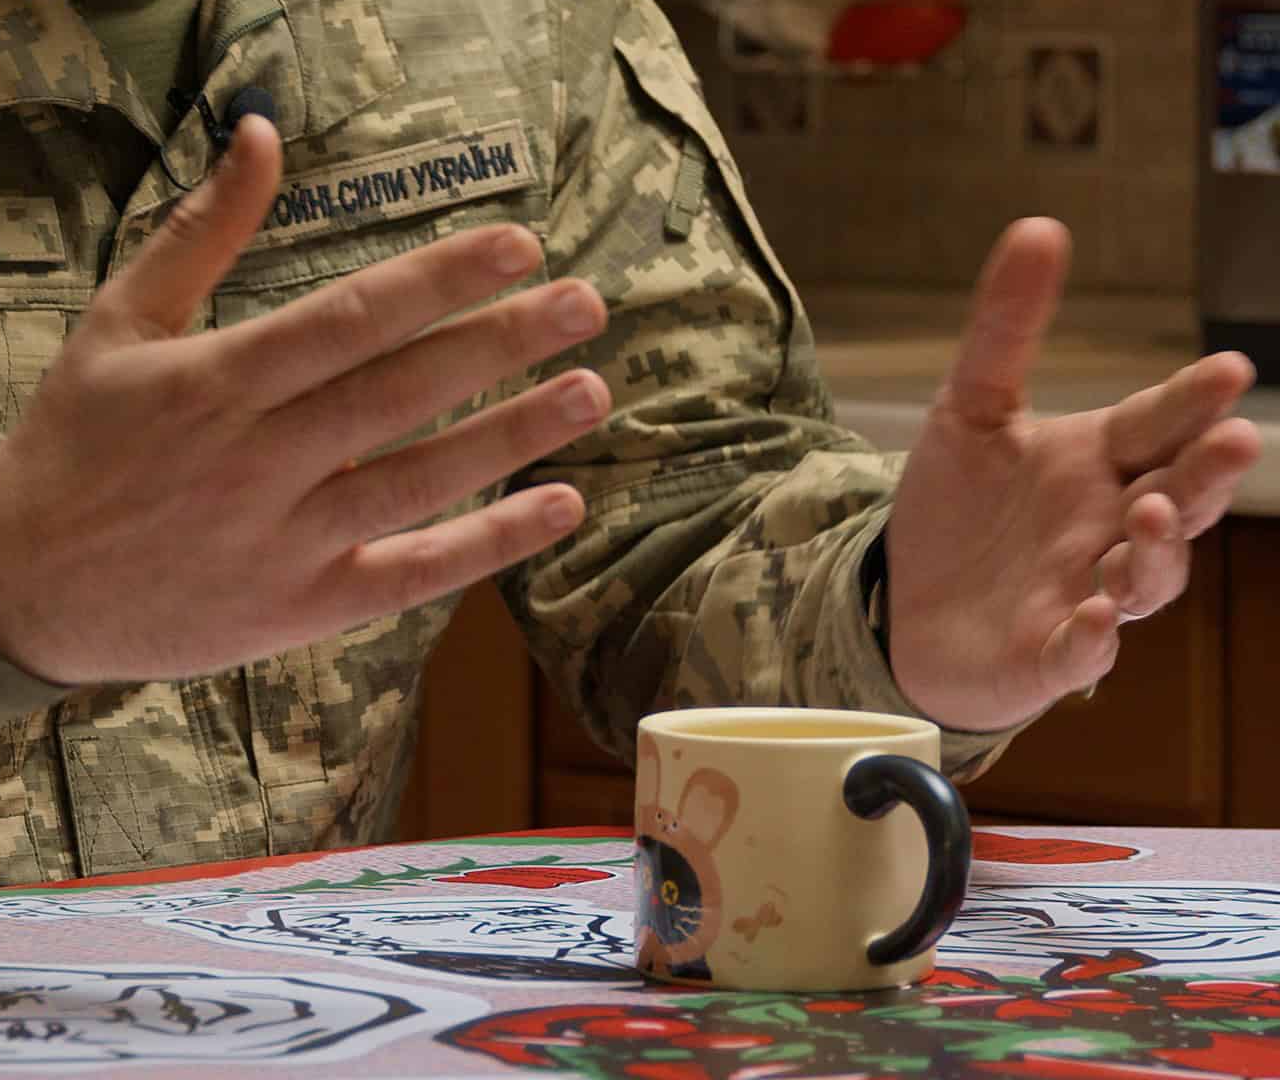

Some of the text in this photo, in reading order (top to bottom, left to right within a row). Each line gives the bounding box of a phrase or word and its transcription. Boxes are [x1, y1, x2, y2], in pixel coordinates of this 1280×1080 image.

[270, 143, 518, 227] ОЙНІ СИЛИ УКРАЇНИ
